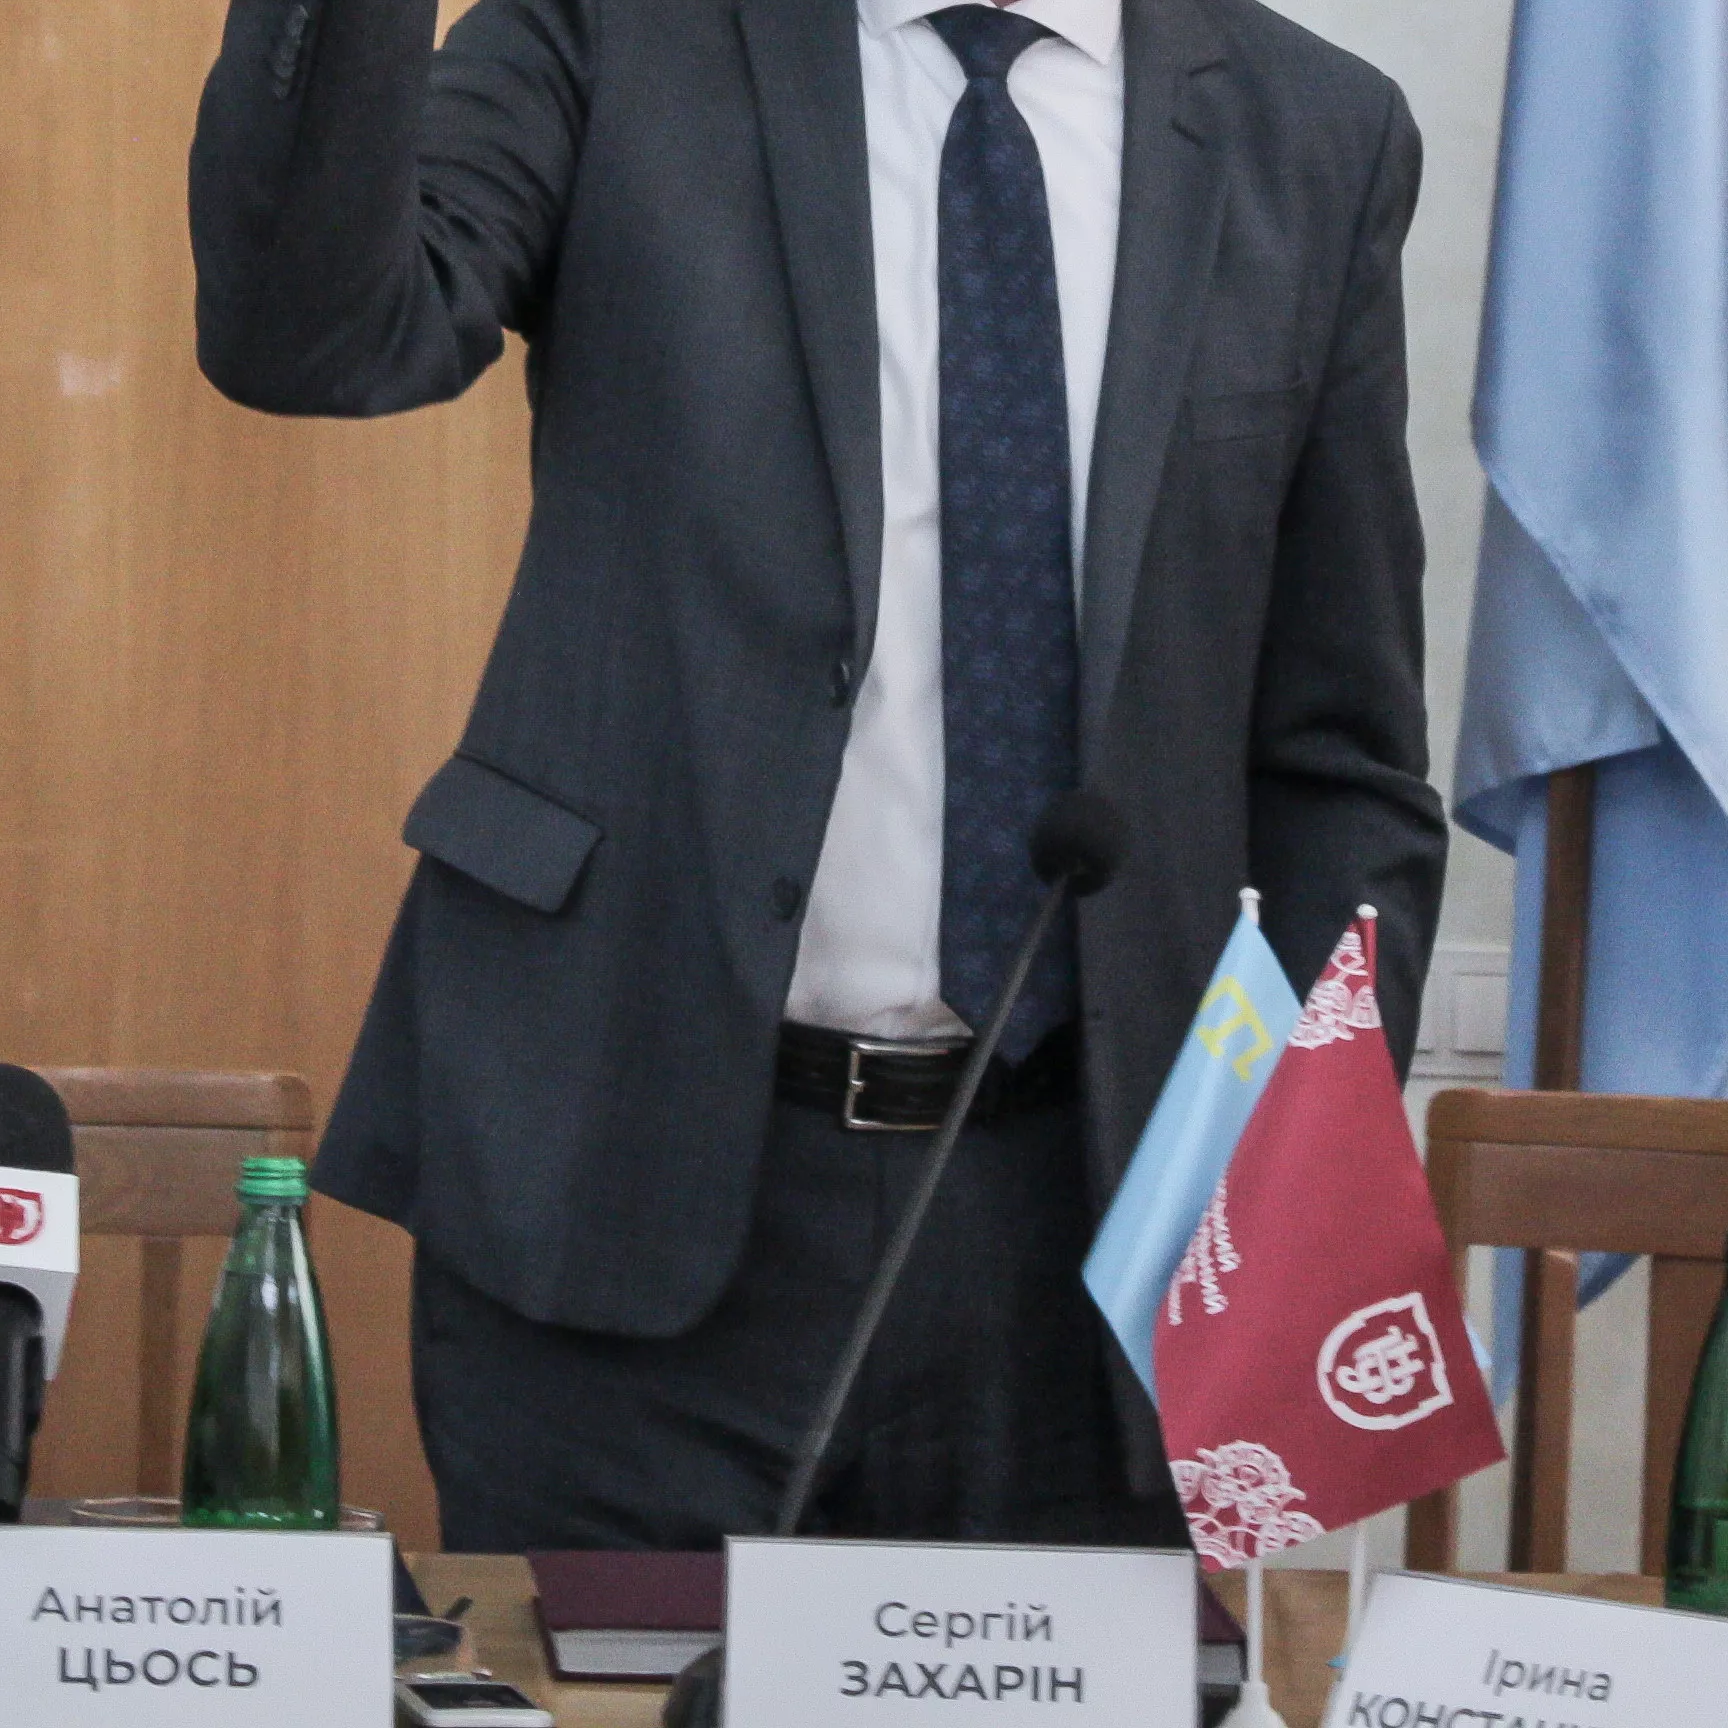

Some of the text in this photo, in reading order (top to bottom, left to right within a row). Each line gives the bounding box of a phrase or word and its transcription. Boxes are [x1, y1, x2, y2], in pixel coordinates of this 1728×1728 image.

[30, 1585, 285, 1629] Анатолій
[874, 1601, 1054, 1649] Сергій
[55, 1644, 261, 1693] ЦЬОСЬ
[838, 1659, 1086, 1703] ЗАХАРІН
[1481, 1648, 1612, 1703] Ірина
